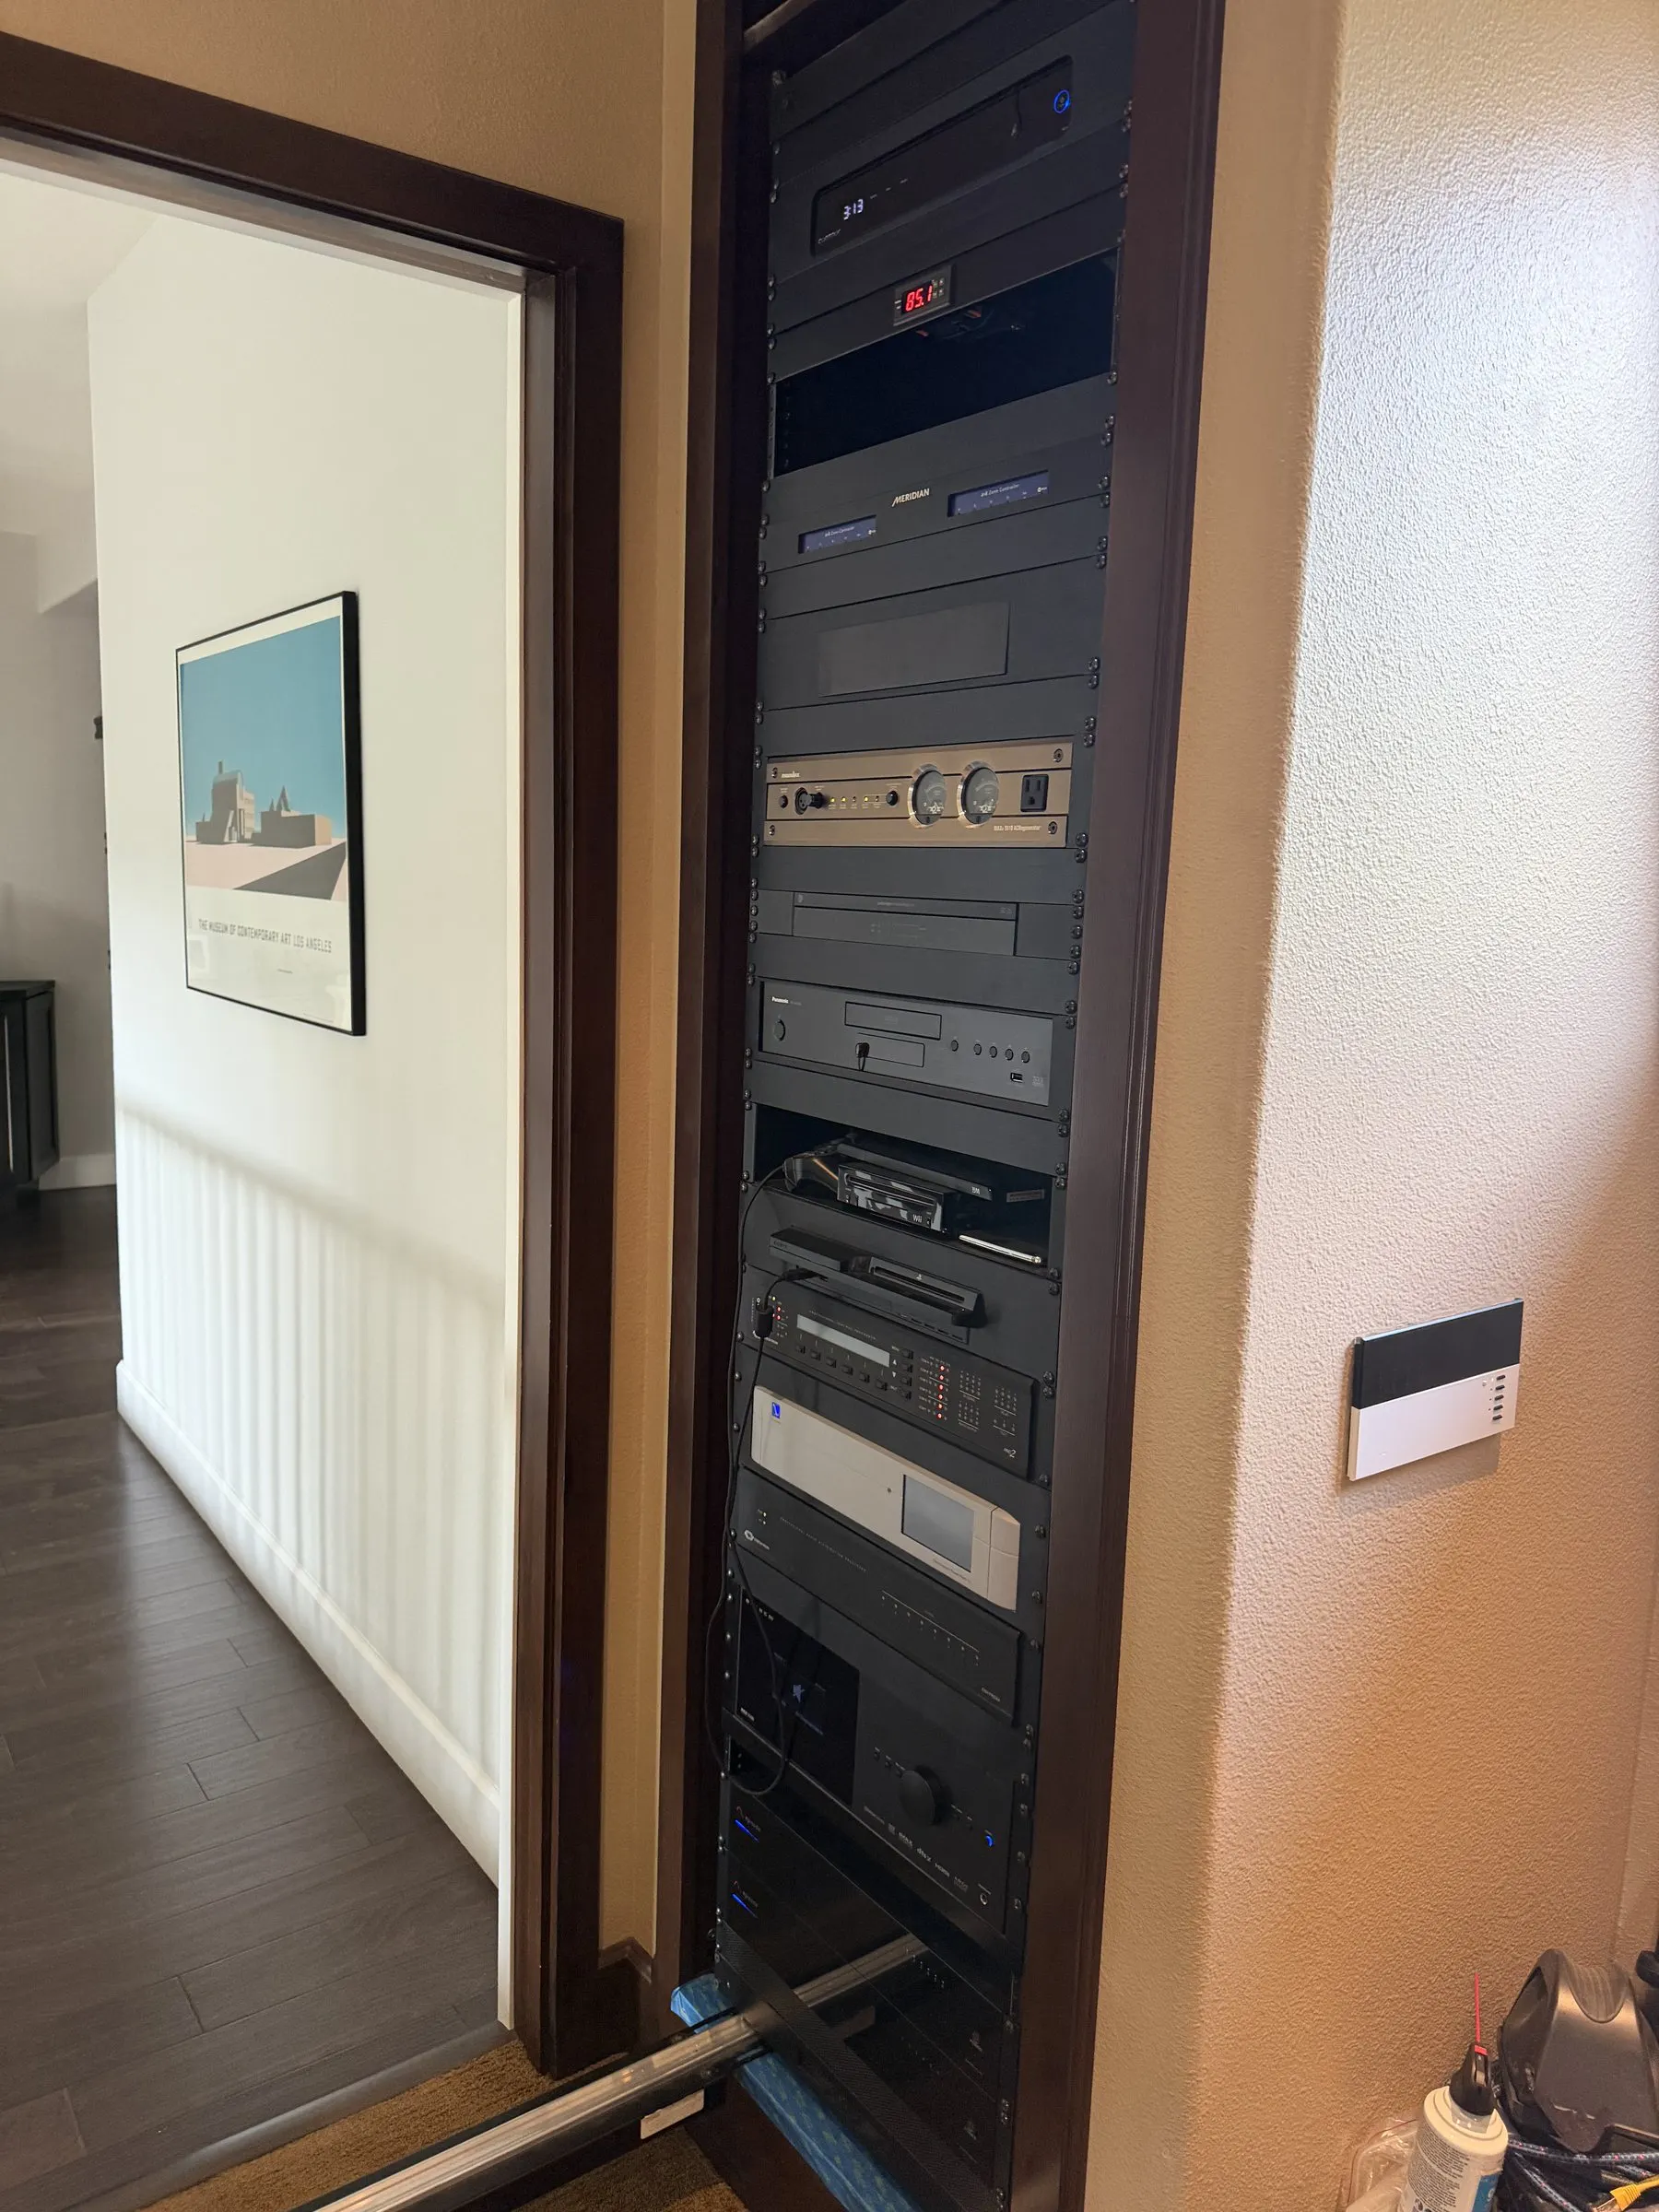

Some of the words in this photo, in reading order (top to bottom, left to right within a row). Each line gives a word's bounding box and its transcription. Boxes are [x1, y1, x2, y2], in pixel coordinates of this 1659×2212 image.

[843, 198, 864, 220] 3:13
[905, 285, 933, 312] 85.1
[891, 488, 930, 508] MERIDIAN
[198, 918, 208, 931] THE
[209, 922, 229, 934] MUSEUM
[229, 924, 236, 935] OF
[237, 924, 279, 943] CONTEMPORARY
[280, 933, 291, 946] ART
[293, 935, 304, 948] LOS
[306, 936, 332, 954] ANGELES
[771, 995, 789, 1005] Panasonic
[912, 1213, 923, 1224] Wii
